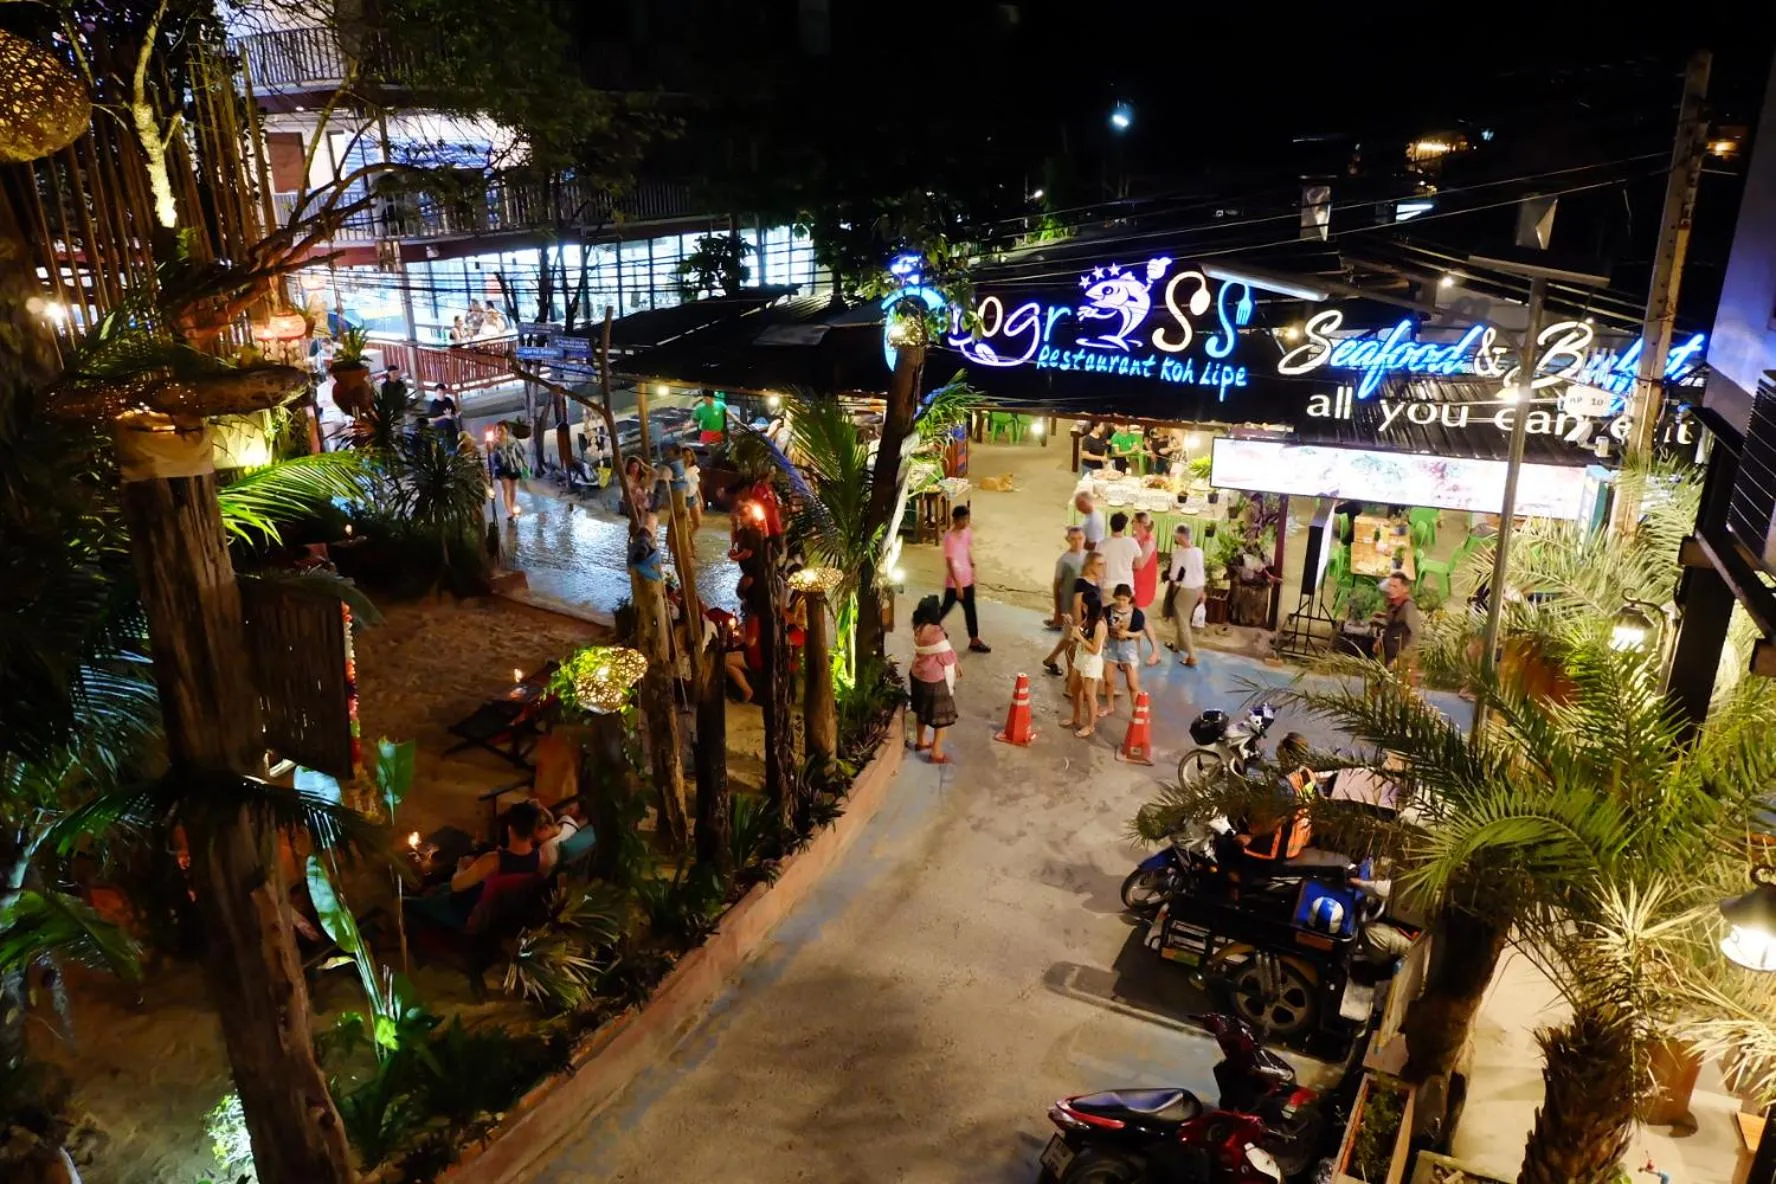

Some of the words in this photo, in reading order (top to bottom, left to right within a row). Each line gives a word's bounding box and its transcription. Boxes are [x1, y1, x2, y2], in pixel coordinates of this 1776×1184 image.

[1037, 344, 1156, 377] Restaurant
[1160, 356, 1194, 384] Koh
[1199, 361, 1248, 402] Lipe
[1278, 309, 1485, 398] Seafood
[1473, 328, 1507, 378] &
[1306, 386, 1353, 420] all
[1379, 398, 1470, 432] you
[1610, 417, 1695, 446] et
